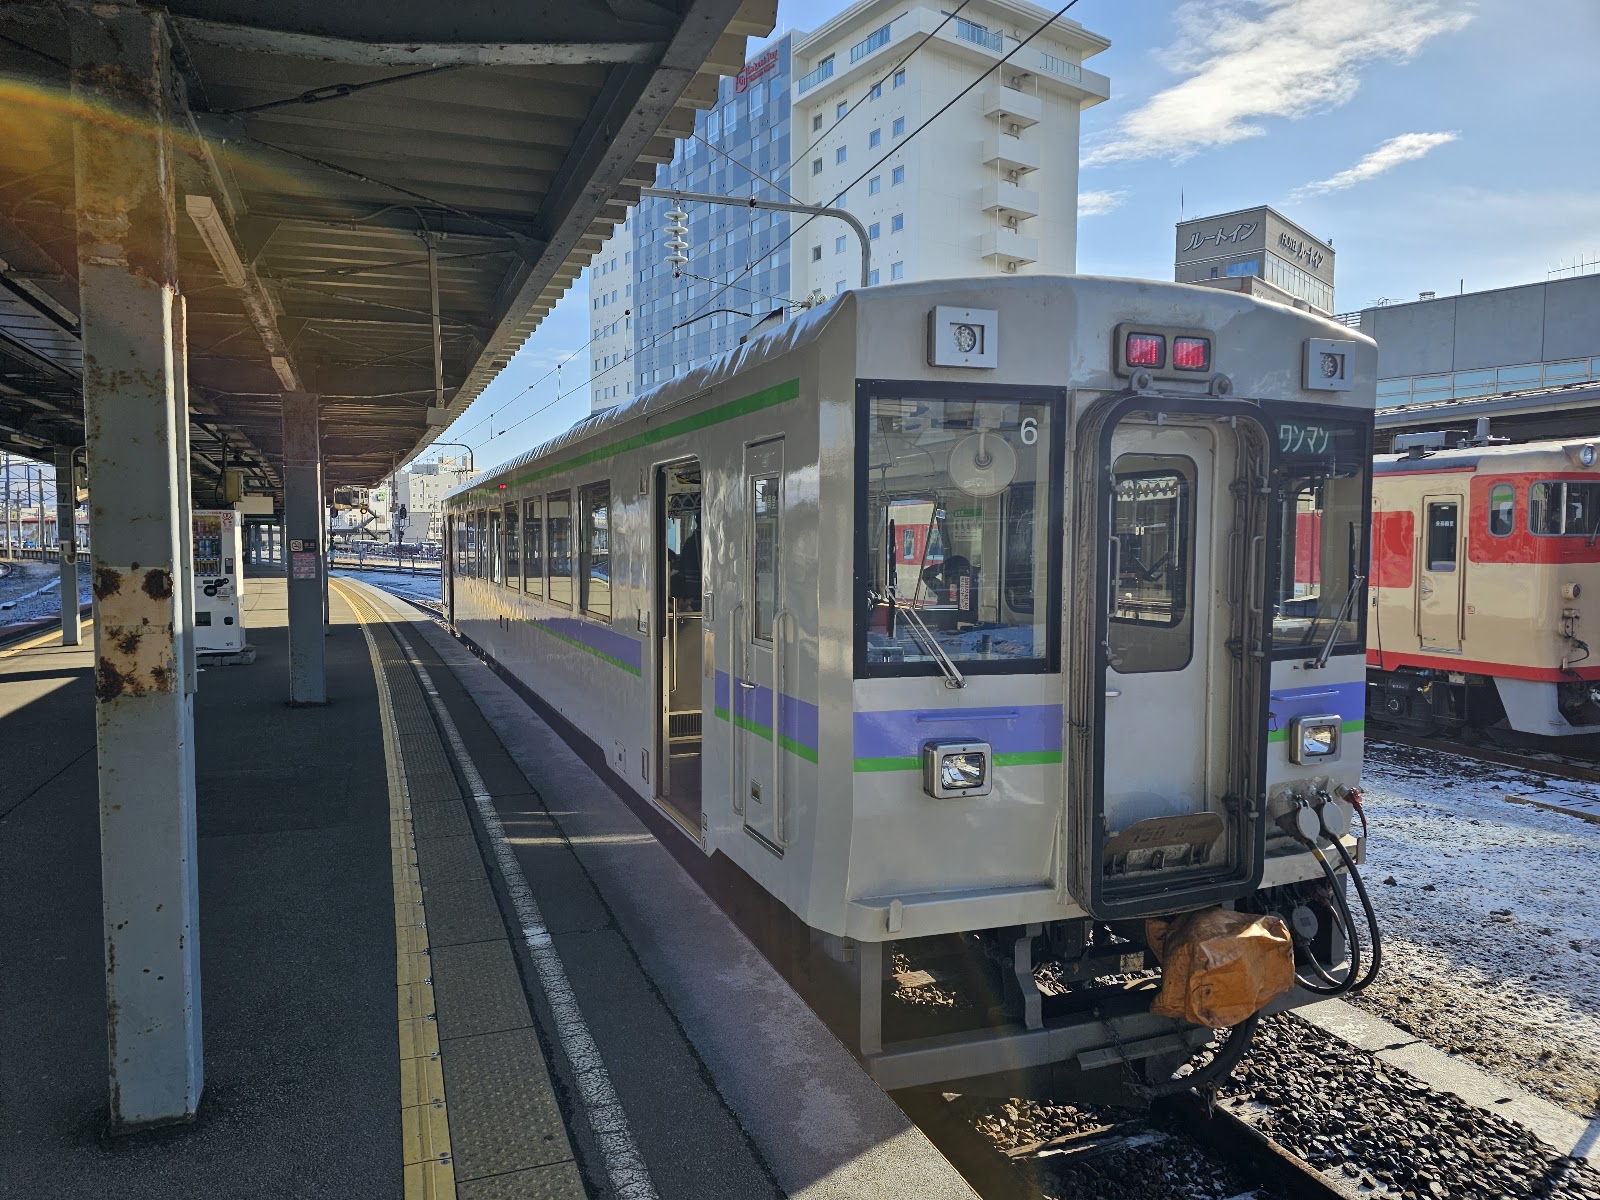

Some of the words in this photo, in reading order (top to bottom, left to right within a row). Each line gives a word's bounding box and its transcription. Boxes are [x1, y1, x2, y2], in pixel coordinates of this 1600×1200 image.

[1183, 222, 1258, 251] ルートイン
[1298, 241, 1324, 269] ルートイン
[1020, 417, 1038, 445] 6
[1279, 424, 1329, 454] ワンマン
